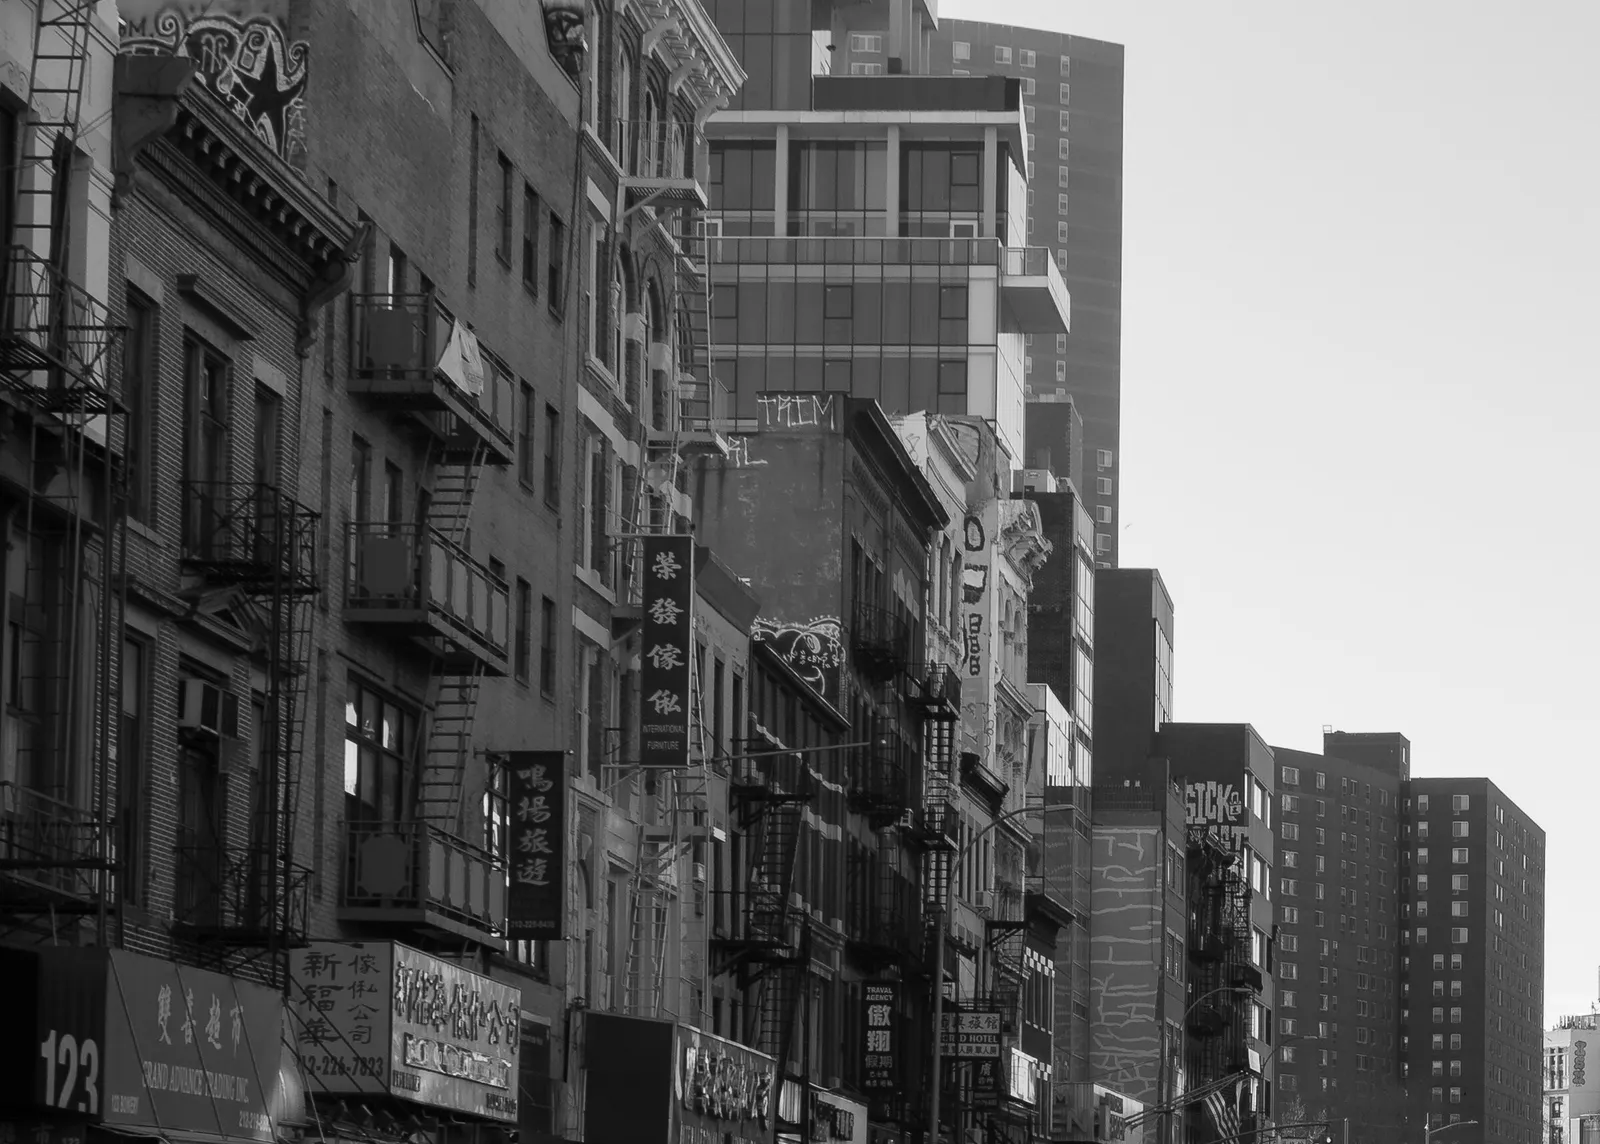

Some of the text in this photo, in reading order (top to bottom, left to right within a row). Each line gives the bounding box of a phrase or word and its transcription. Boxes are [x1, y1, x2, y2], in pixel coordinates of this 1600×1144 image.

[757, 394, 835, 431] TRIM
[647, 551, 685, 716] 榮發傢俬
[642, 724, 685, 734] INTERNATIONAL
[647, 741, 680, 750] FURNITURE
[1185, 781, 1238, 824] SICK
[516, 763, 554, 886] 鳴揚旅遊
[969, 1034, 998, 1043] HOTEL
[41, 1029, 98, 1115] 123
[142, 1060, 169, 1090] GRAND
[169, 1064, 204, 1096] ADVANCE
[204, 1072, 236, 1100] TRADING
